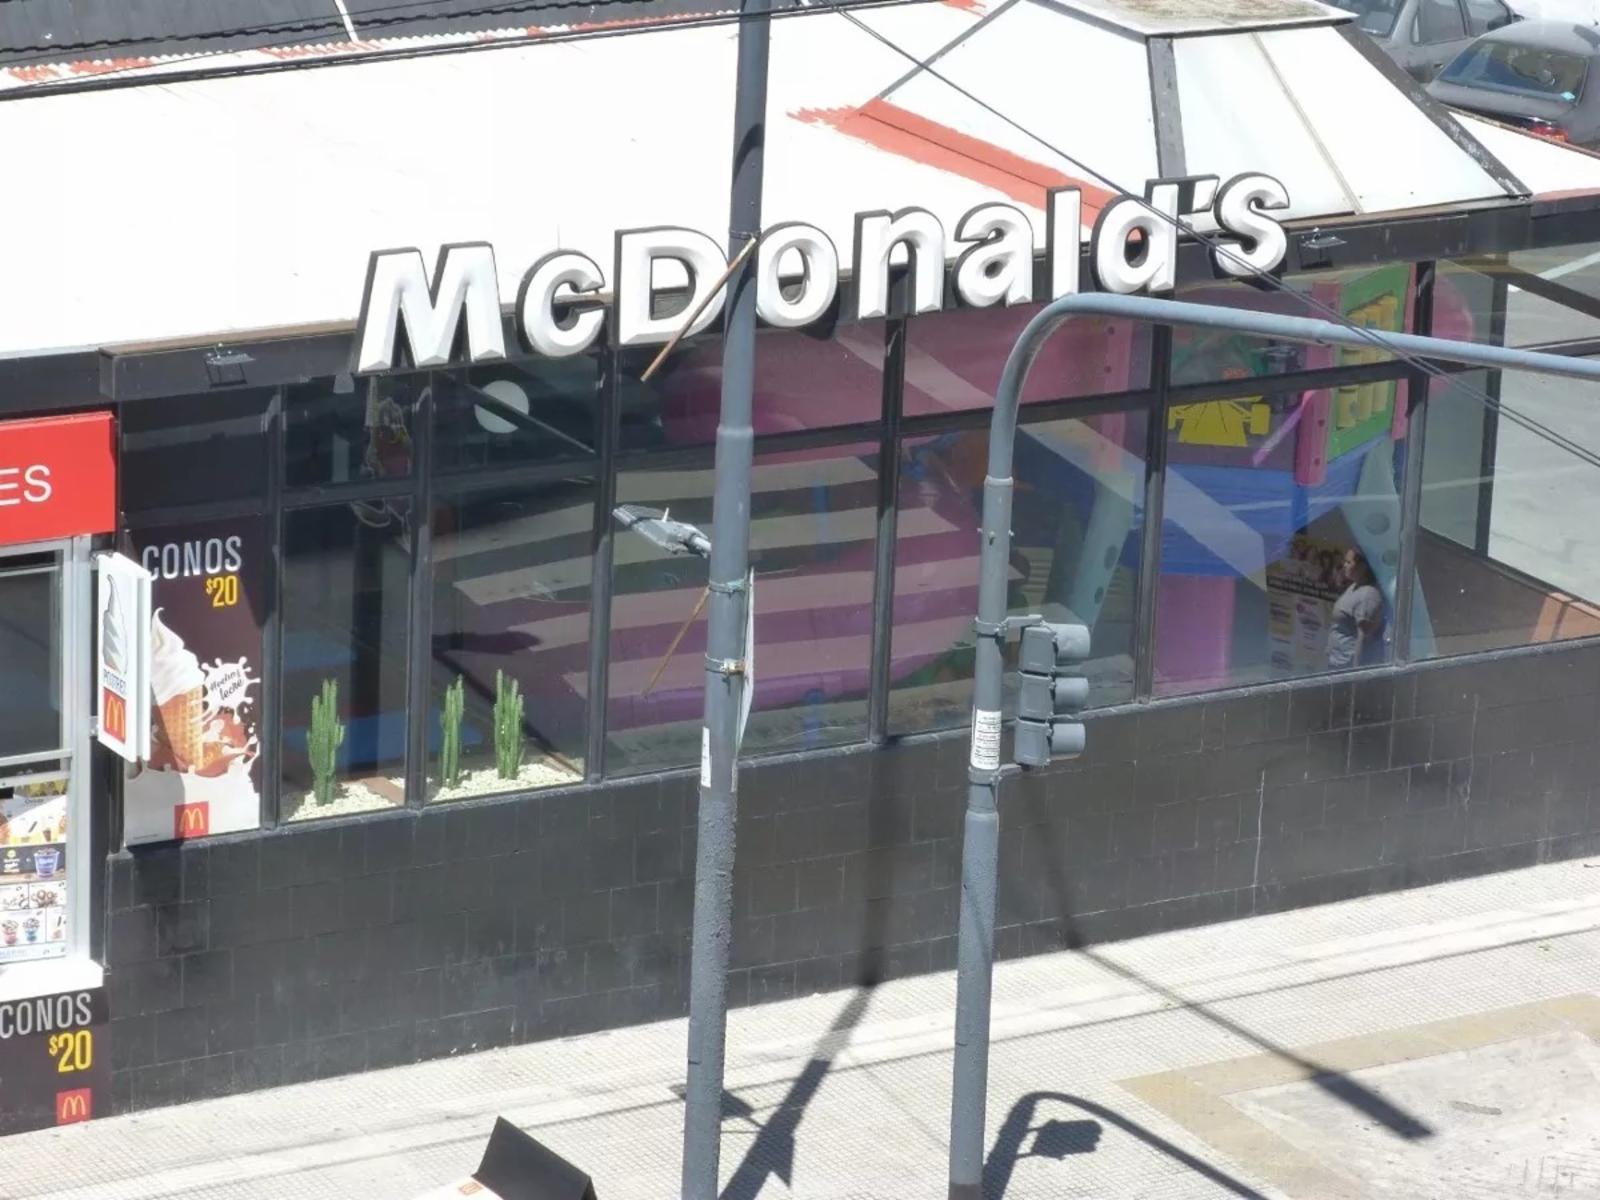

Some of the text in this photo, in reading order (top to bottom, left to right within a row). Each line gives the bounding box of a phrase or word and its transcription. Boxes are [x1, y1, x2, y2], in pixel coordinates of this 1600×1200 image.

[355, 171, 1290, 374] McDonald's
[142, 535, 242, 582] CONOS
[206, 575, 239, 608] $20
[0, 992, 92, 1039] CONOS
[48, 1030, 92, 1073] $20
